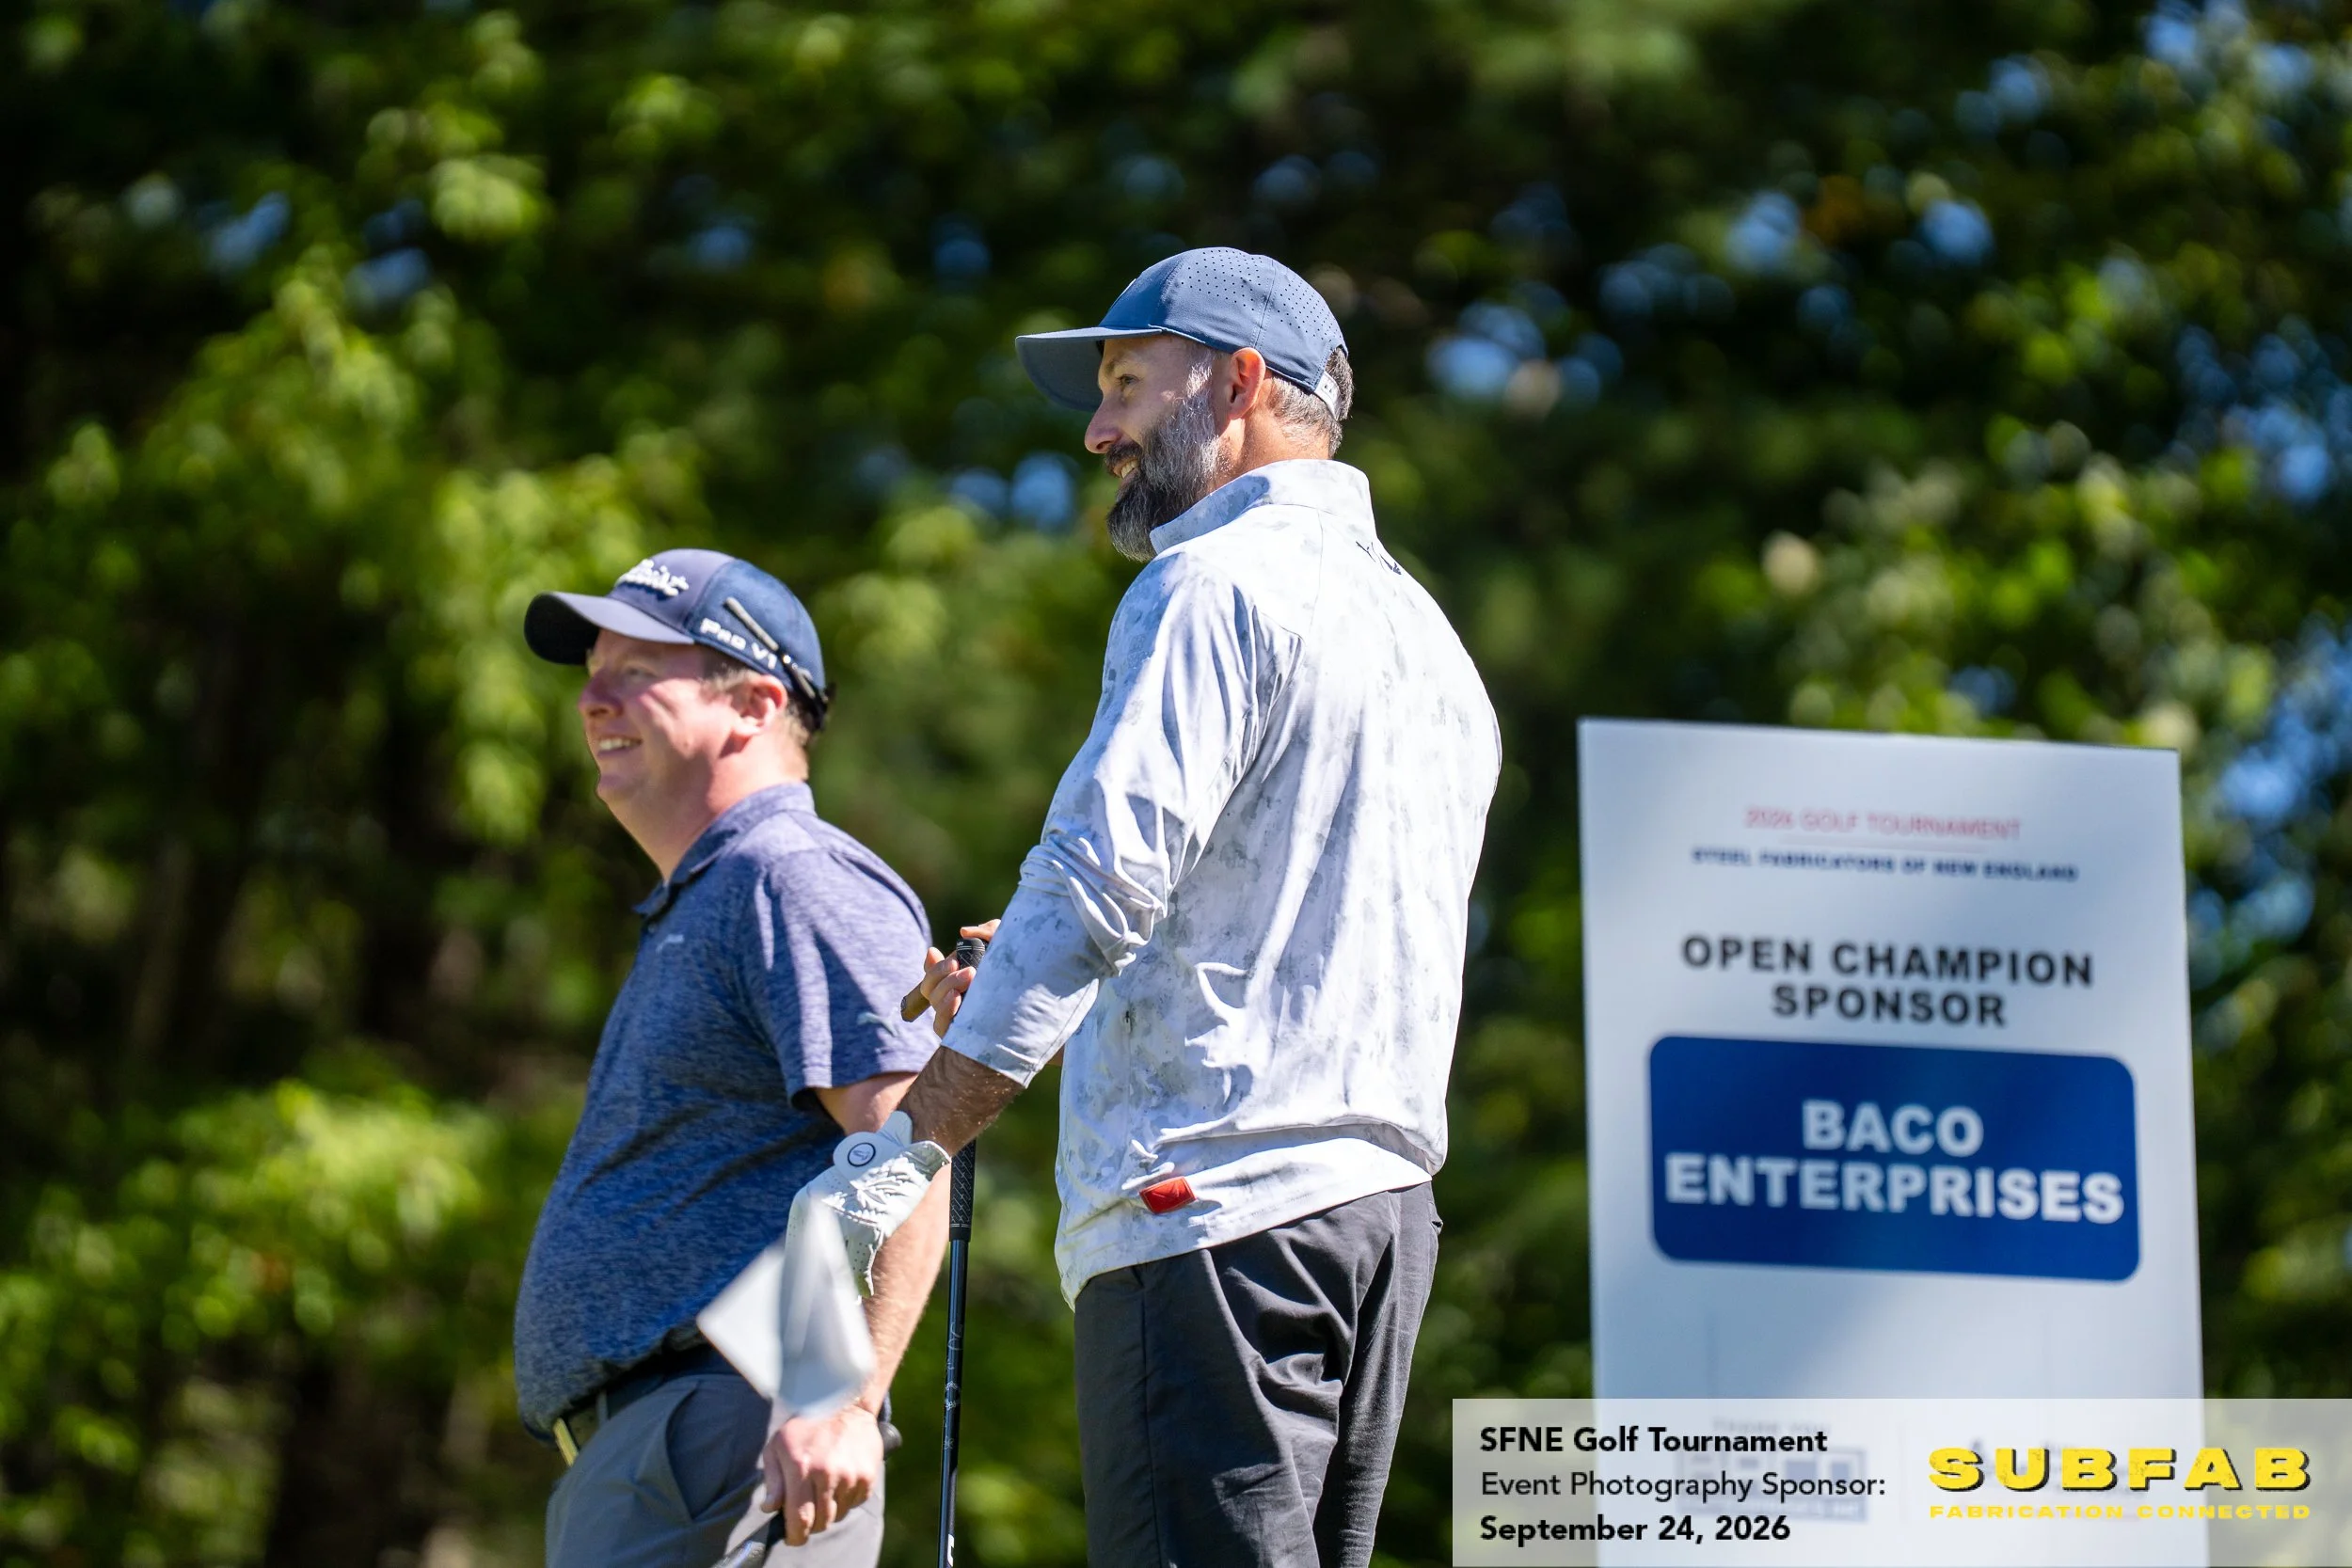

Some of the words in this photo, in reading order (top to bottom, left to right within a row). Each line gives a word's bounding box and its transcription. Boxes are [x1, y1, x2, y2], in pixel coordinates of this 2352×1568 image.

[752, 642, 777, 670] V1
[1801, 807, 1858, 832] GOLF
[1867, 811, 2020, 840] TOURNAMENT
[1692, 847, 1750, 866] STEEL
[1758, 849, 1895, 873] FABRICATORS
[1900, 856, 1927, 875] OF
[1933, 858, 1978, 877] NEW
[1982, 860, 2079, 883] ENGLAND
[1682, 936, 1811, 973] OPEN
[1831, 942, 2093, 987] CHAMPION
[1773, 985, 2006, 1026] SPONSOR
[1802, 1099, 1984, 1157] BACO
[1664, 1151, 2124, 1224] ENTERPRISES
